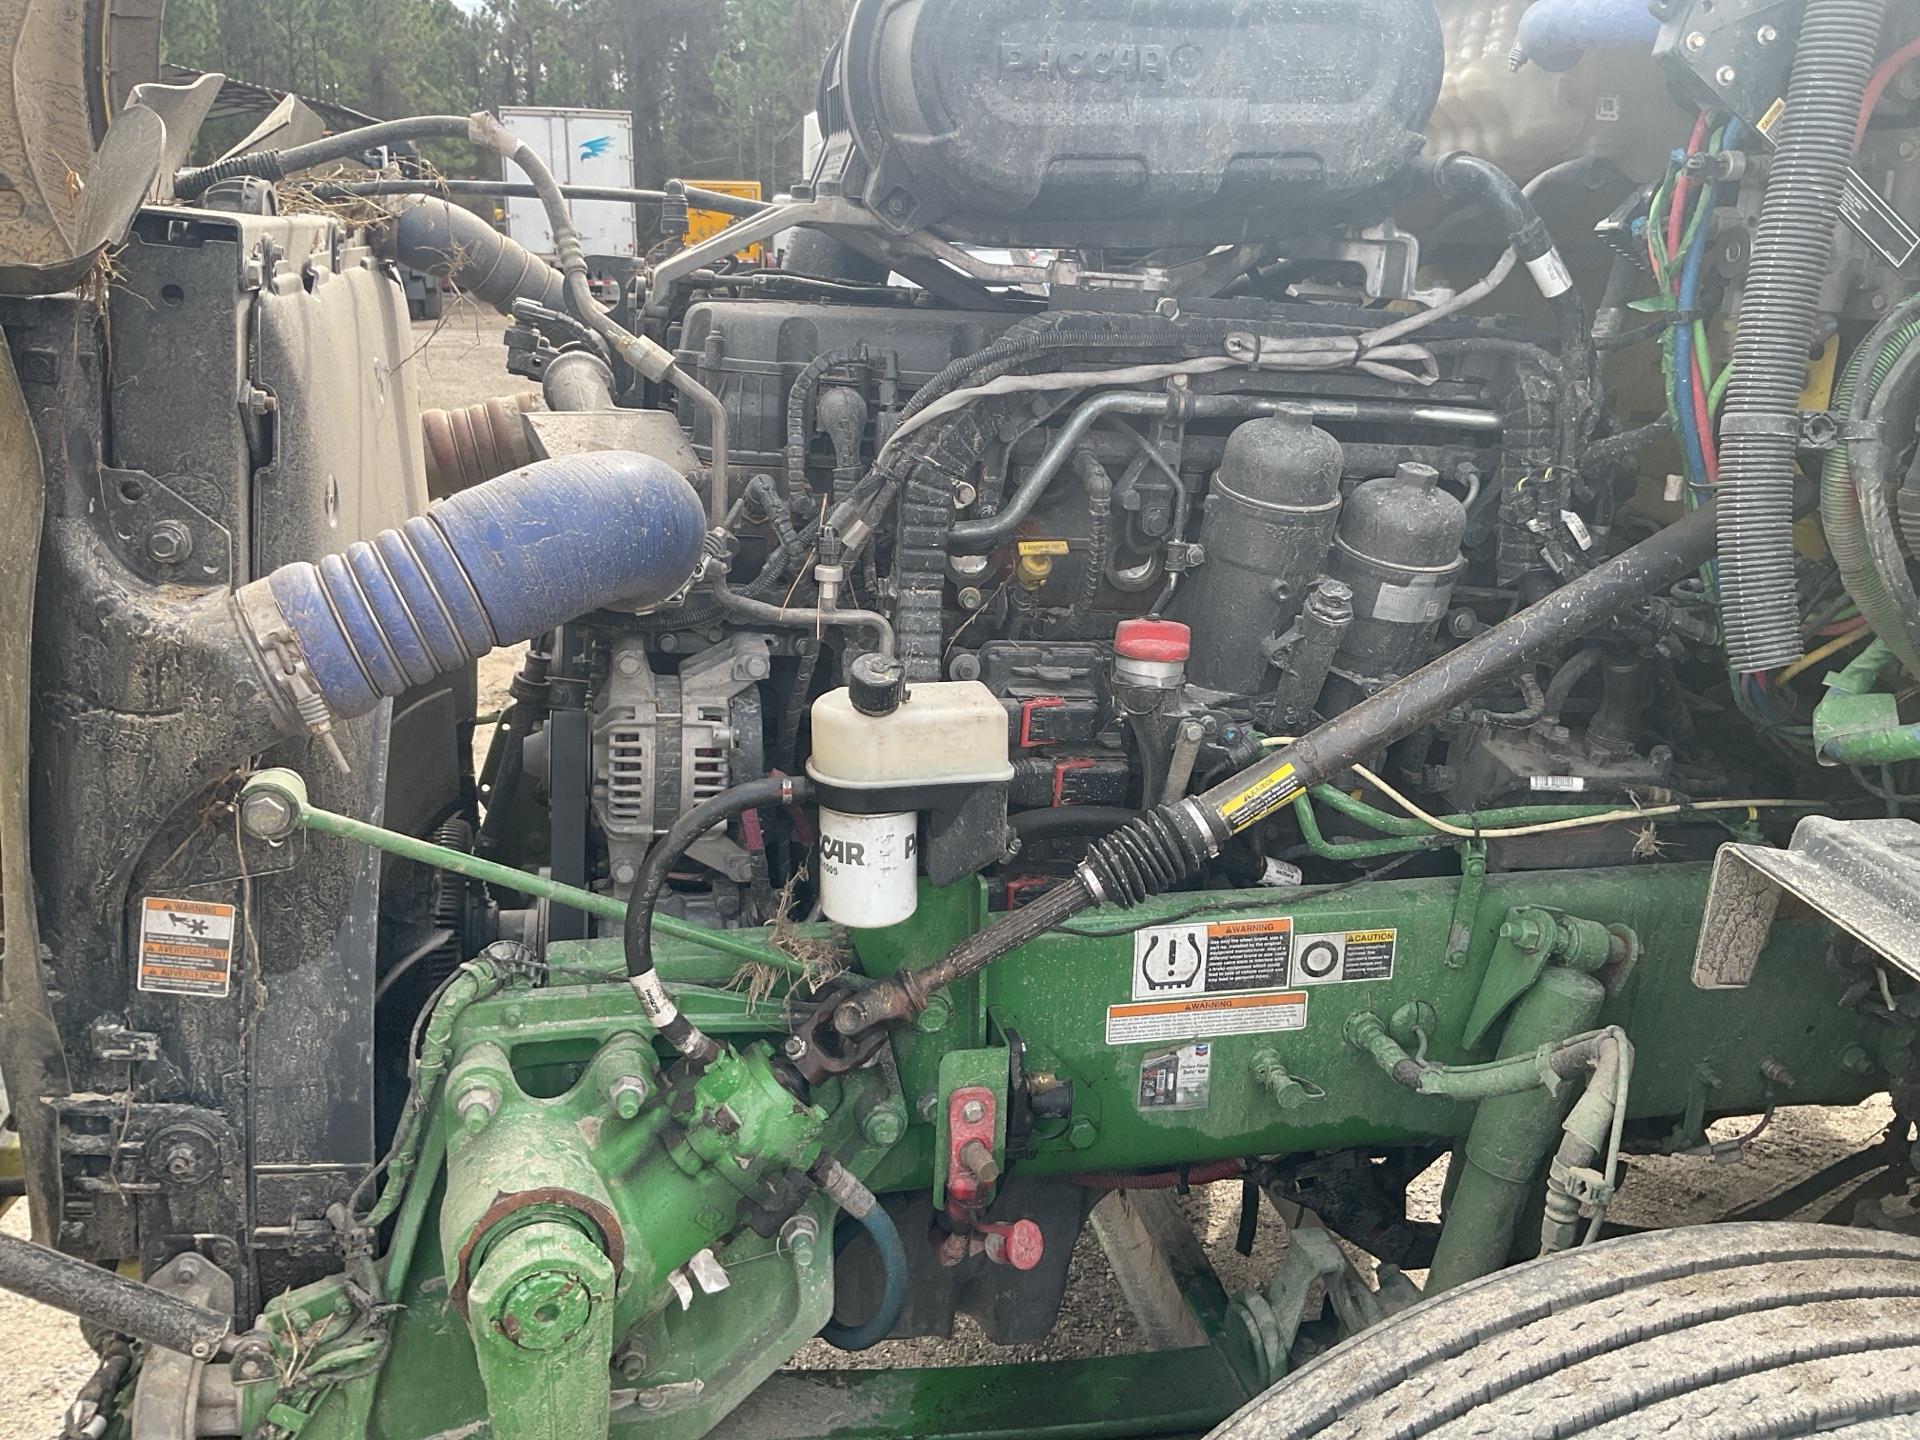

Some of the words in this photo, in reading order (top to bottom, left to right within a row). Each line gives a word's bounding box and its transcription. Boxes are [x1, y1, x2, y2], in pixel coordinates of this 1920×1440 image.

[998, 43, 1169, 83] PACCAR
[820, 832, 866, 866] CAR
[174, 903, 217, 914] WARNING
[1232, 924, 1274, 933] WARNING
[1355, 933, 1393, 942] CAUTION
[160, 967, 221, 980] ADVERTENCIA
[1191, 1000, 1232, 1010] WARNING
